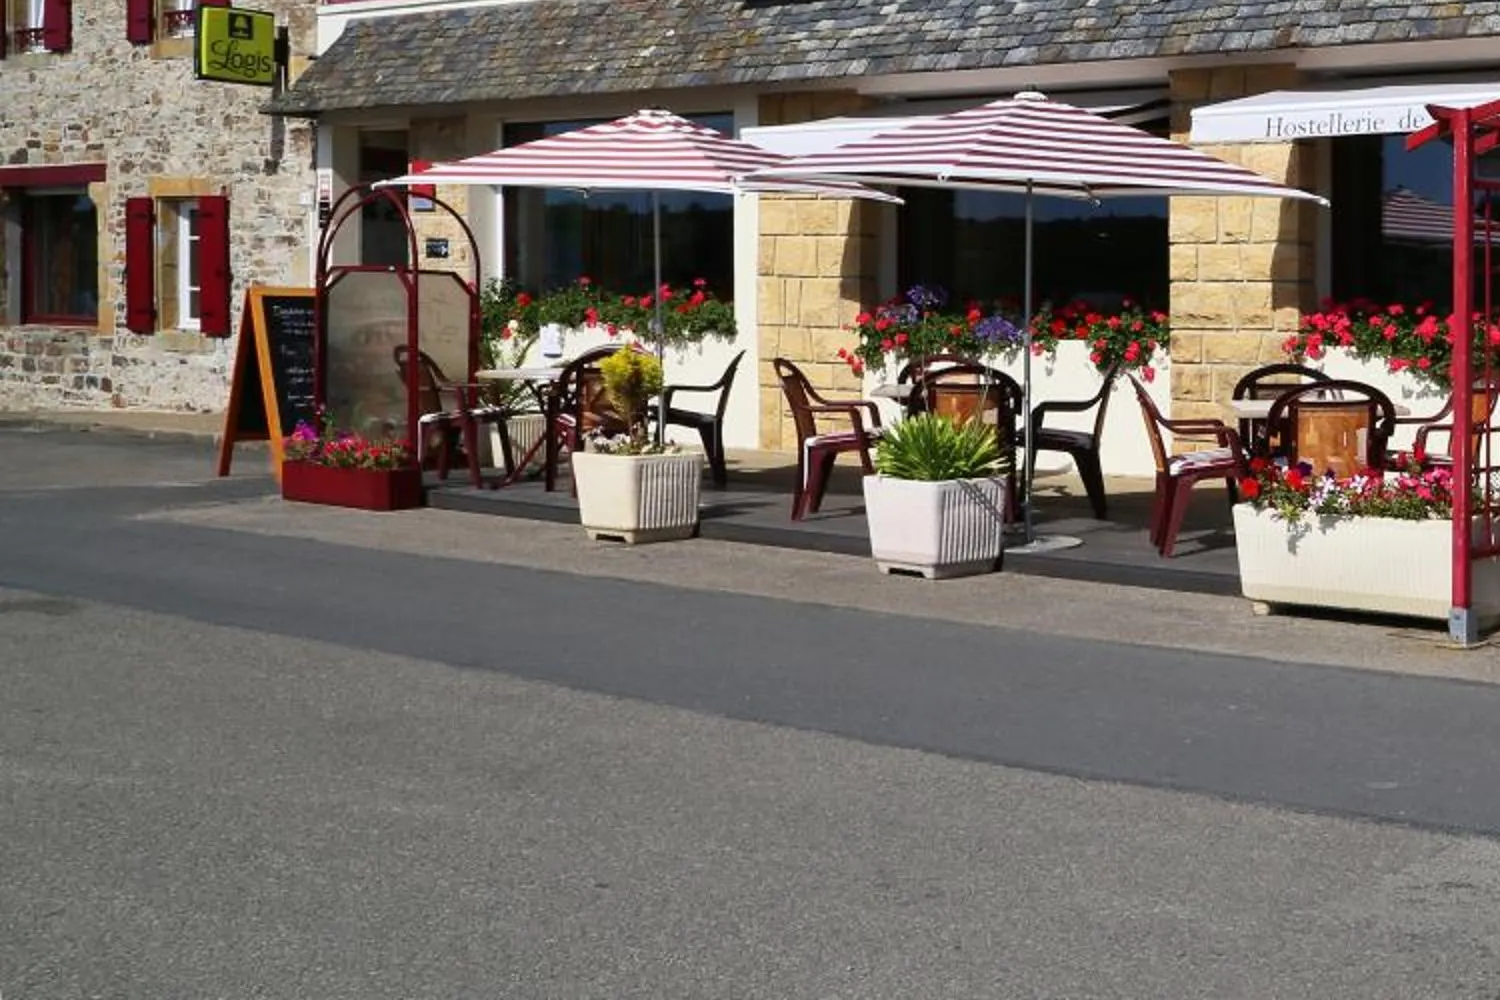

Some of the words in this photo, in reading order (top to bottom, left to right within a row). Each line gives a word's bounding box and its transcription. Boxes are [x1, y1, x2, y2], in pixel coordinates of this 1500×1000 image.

[208, 39, 271, 78] Logis
[1266, 111, 1385, 137] Hostellerie
[1398, 107, 1425, 130] de
